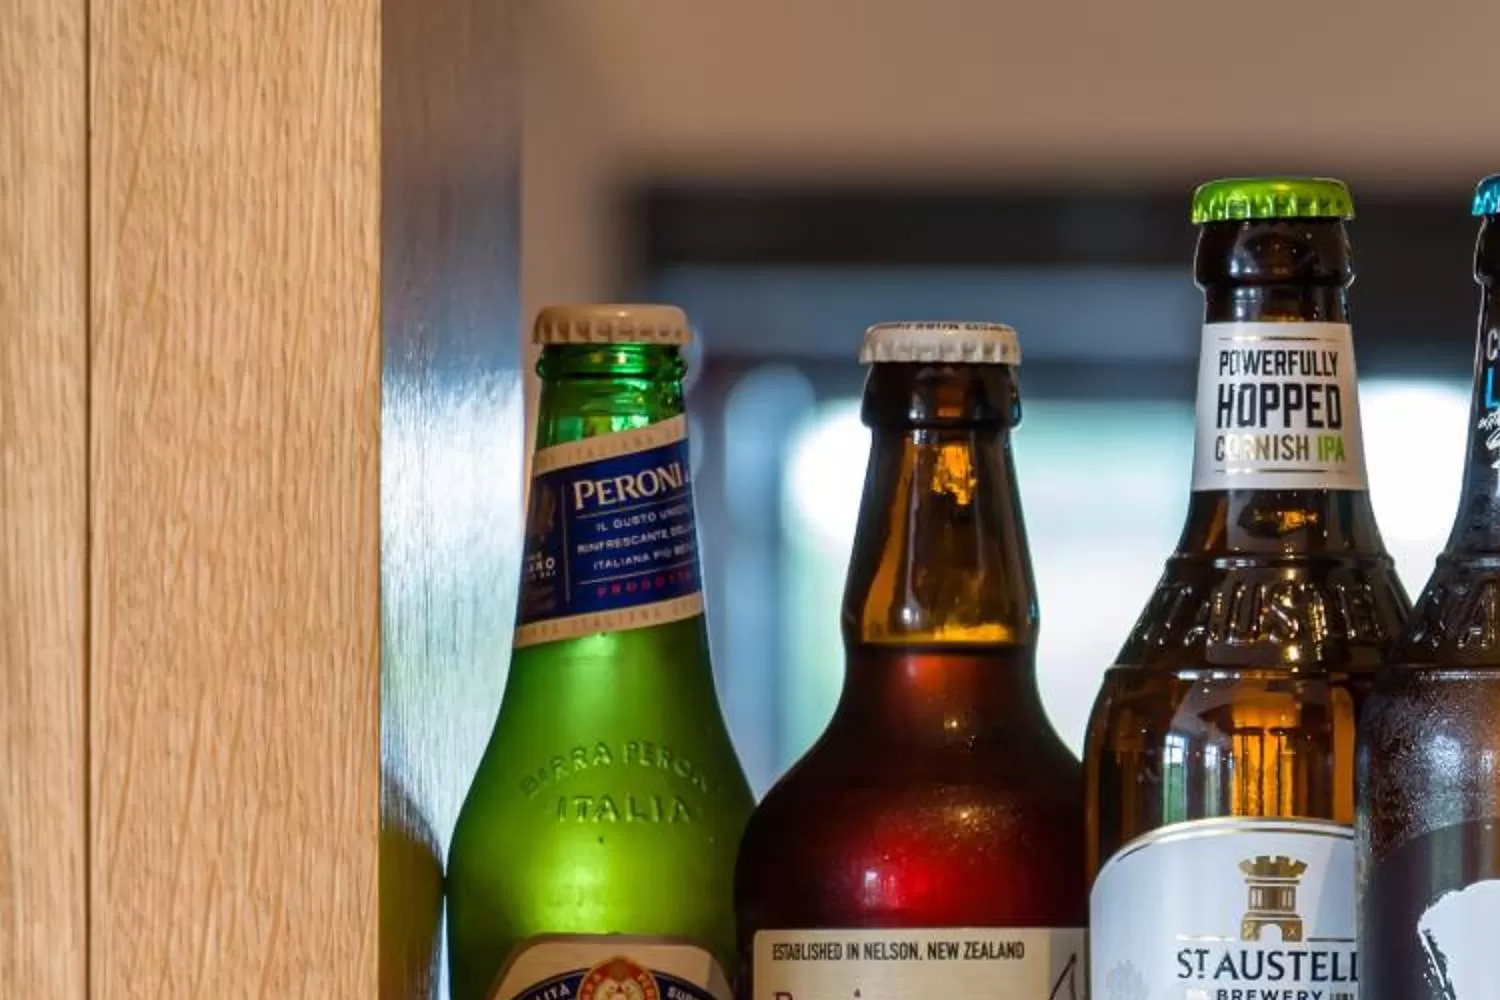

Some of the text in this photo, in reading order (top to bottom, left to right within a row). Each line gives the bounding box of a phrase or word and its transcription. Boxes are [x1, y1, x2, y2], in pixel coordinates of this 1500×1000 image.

[1219, 351, 1339, 377] POWERFULLY
[1216, 383, 1343, 430] HOPPED
[1215, 434, 1346, 463] CORNISH IPA
[573, 461, 684, 510] PERONI
[612, 513, 657, 530] GUSTO
[593, 551, 650, 571] ITALIANA
[622, 739, 708, 793] PEROI
[556, 793, 691, 824] ITALIA
[772, 941, 843, 961] ESTABLISHED
[846, 941, 861, 960] IN
[927, 941, 960, 960] NEW
[963, 941, 1026, 960] ZEALAND
